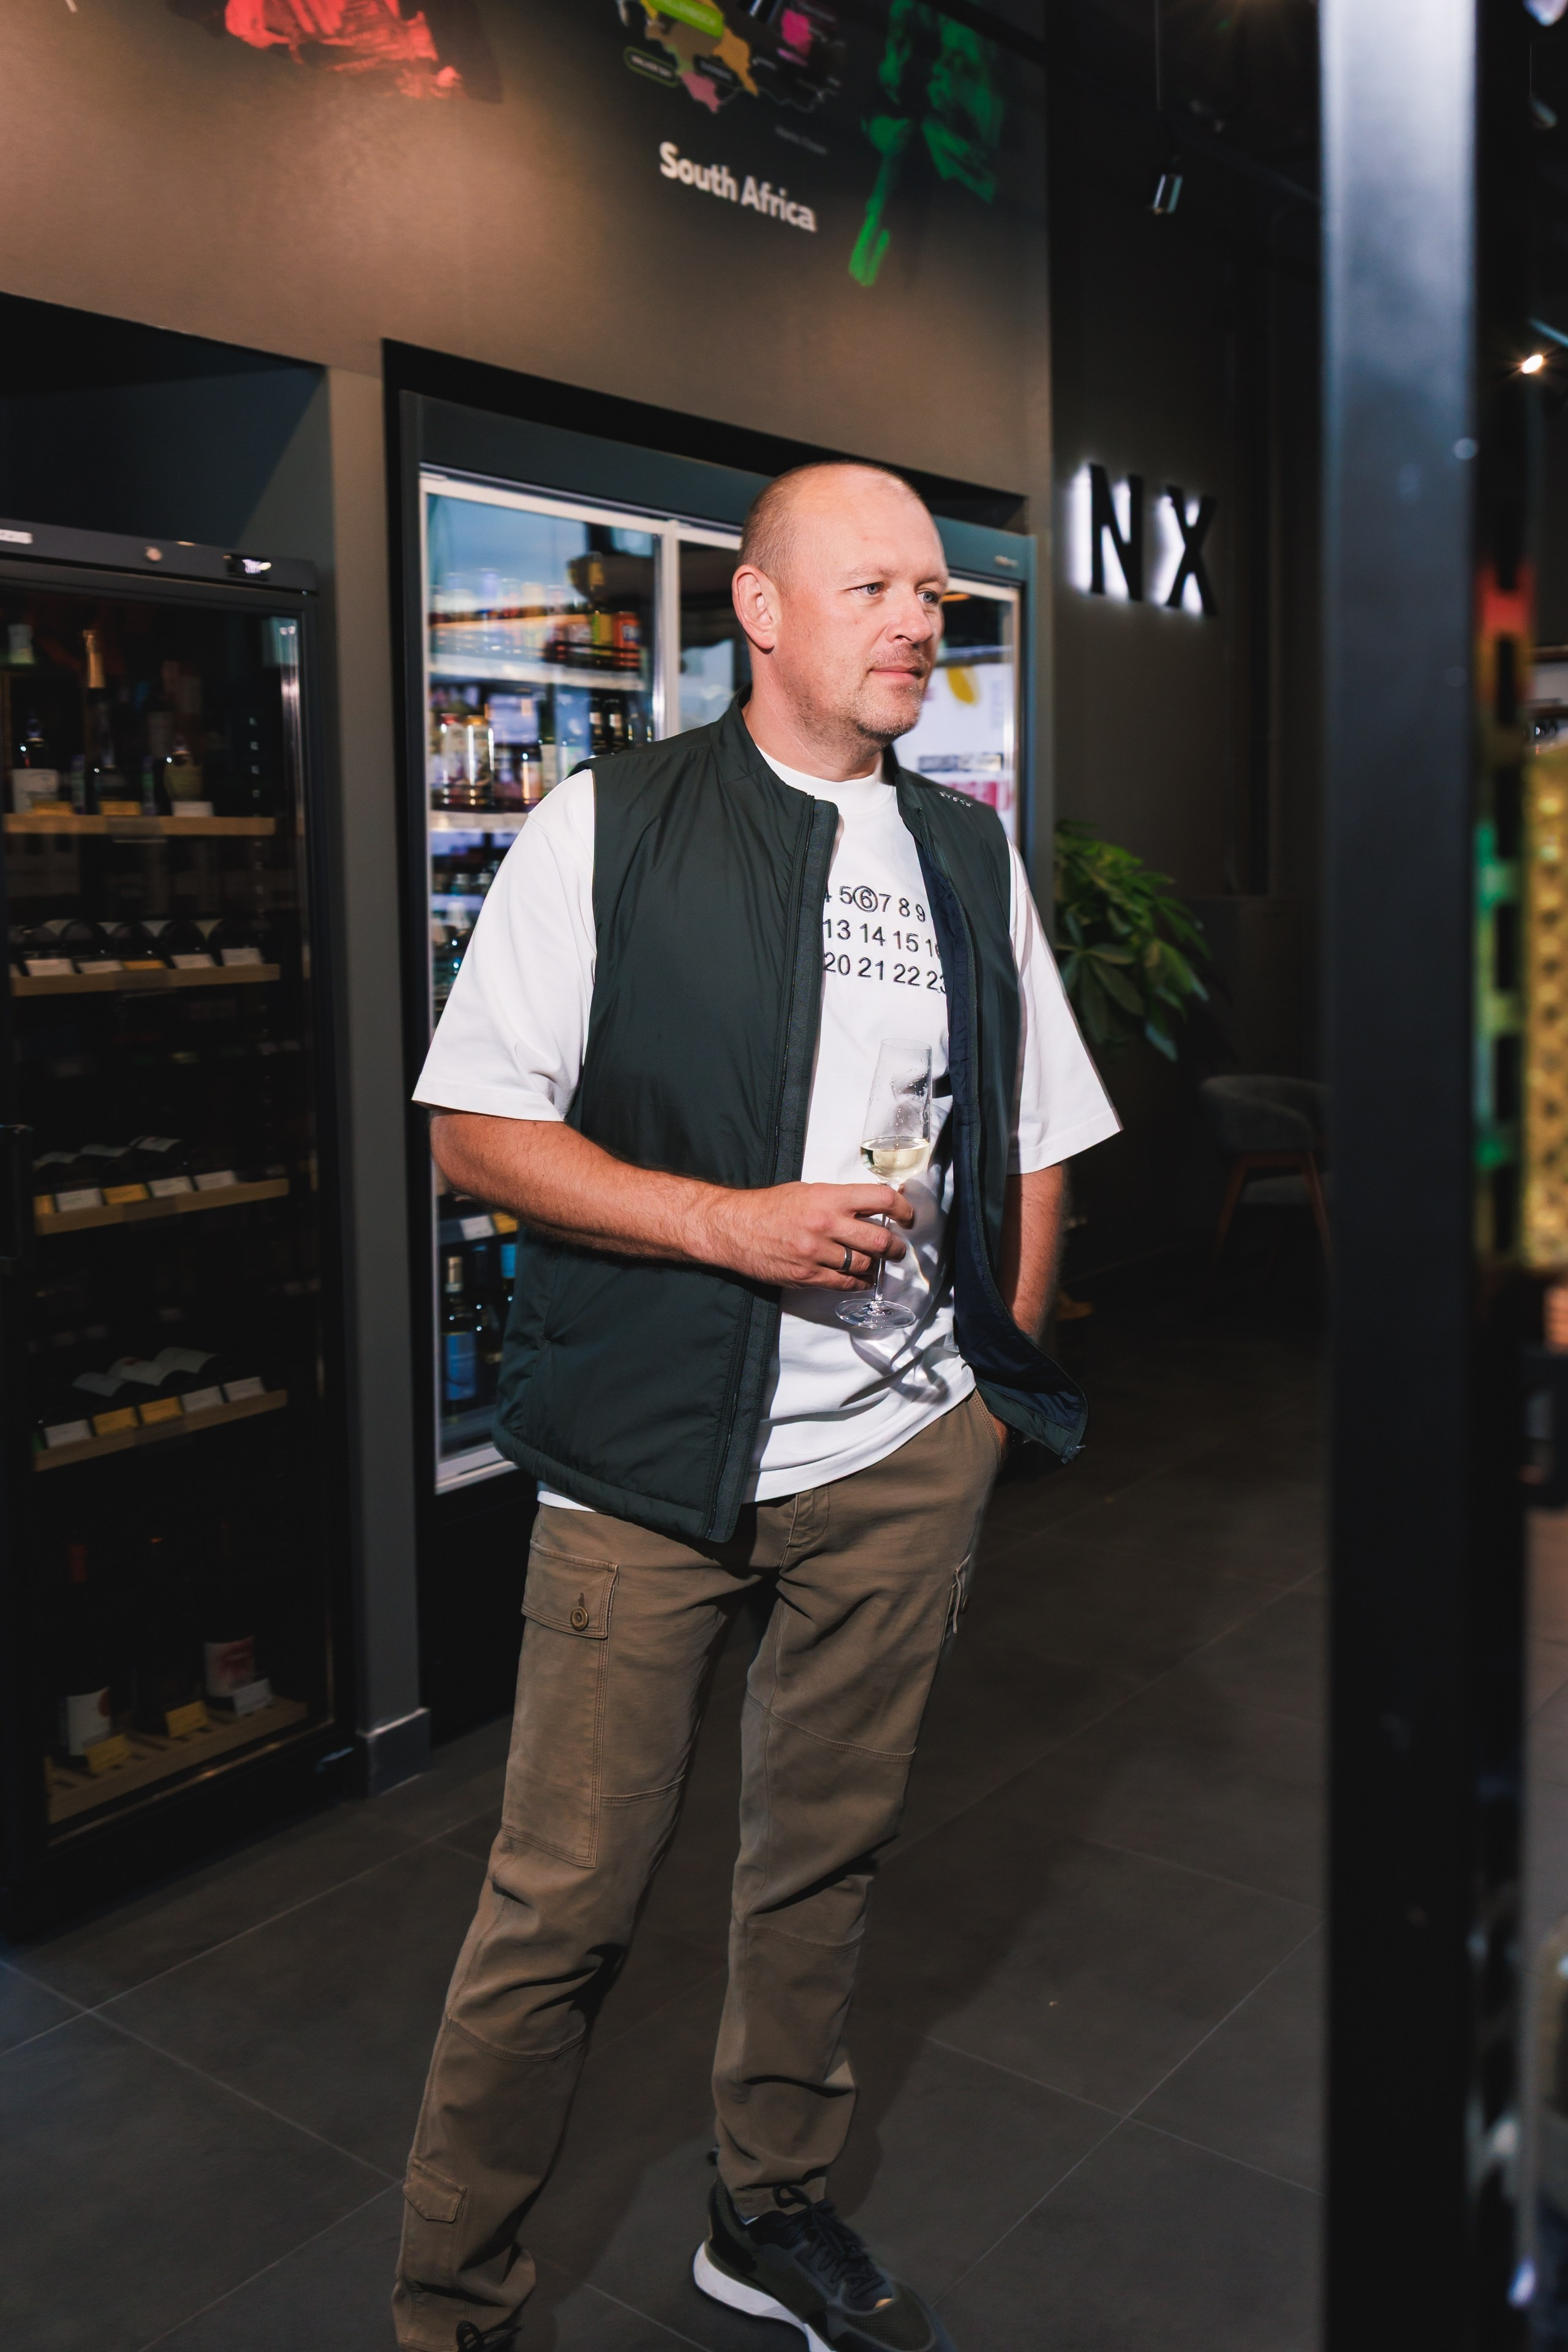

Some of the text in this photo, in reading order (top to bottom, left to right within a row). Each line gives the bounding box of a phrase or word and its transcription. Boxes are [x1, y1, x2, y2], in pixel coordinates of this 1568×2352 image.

[660, 141, 818, 233] South Africa
[840, 886, 853, 905] 5
[878, 893, 892, 912] 7
[899, 897, 911, 918] 8
[915, 903, 925, 922] 9
[823, 919, 851, 940] 13
[859, 923, 886, 946] 14
[892, 930, 919, 952] 15
[823, 951, 851, 976] 20
[857, 957, 884, 980] 21
[893, 963, 921, 987] 22
